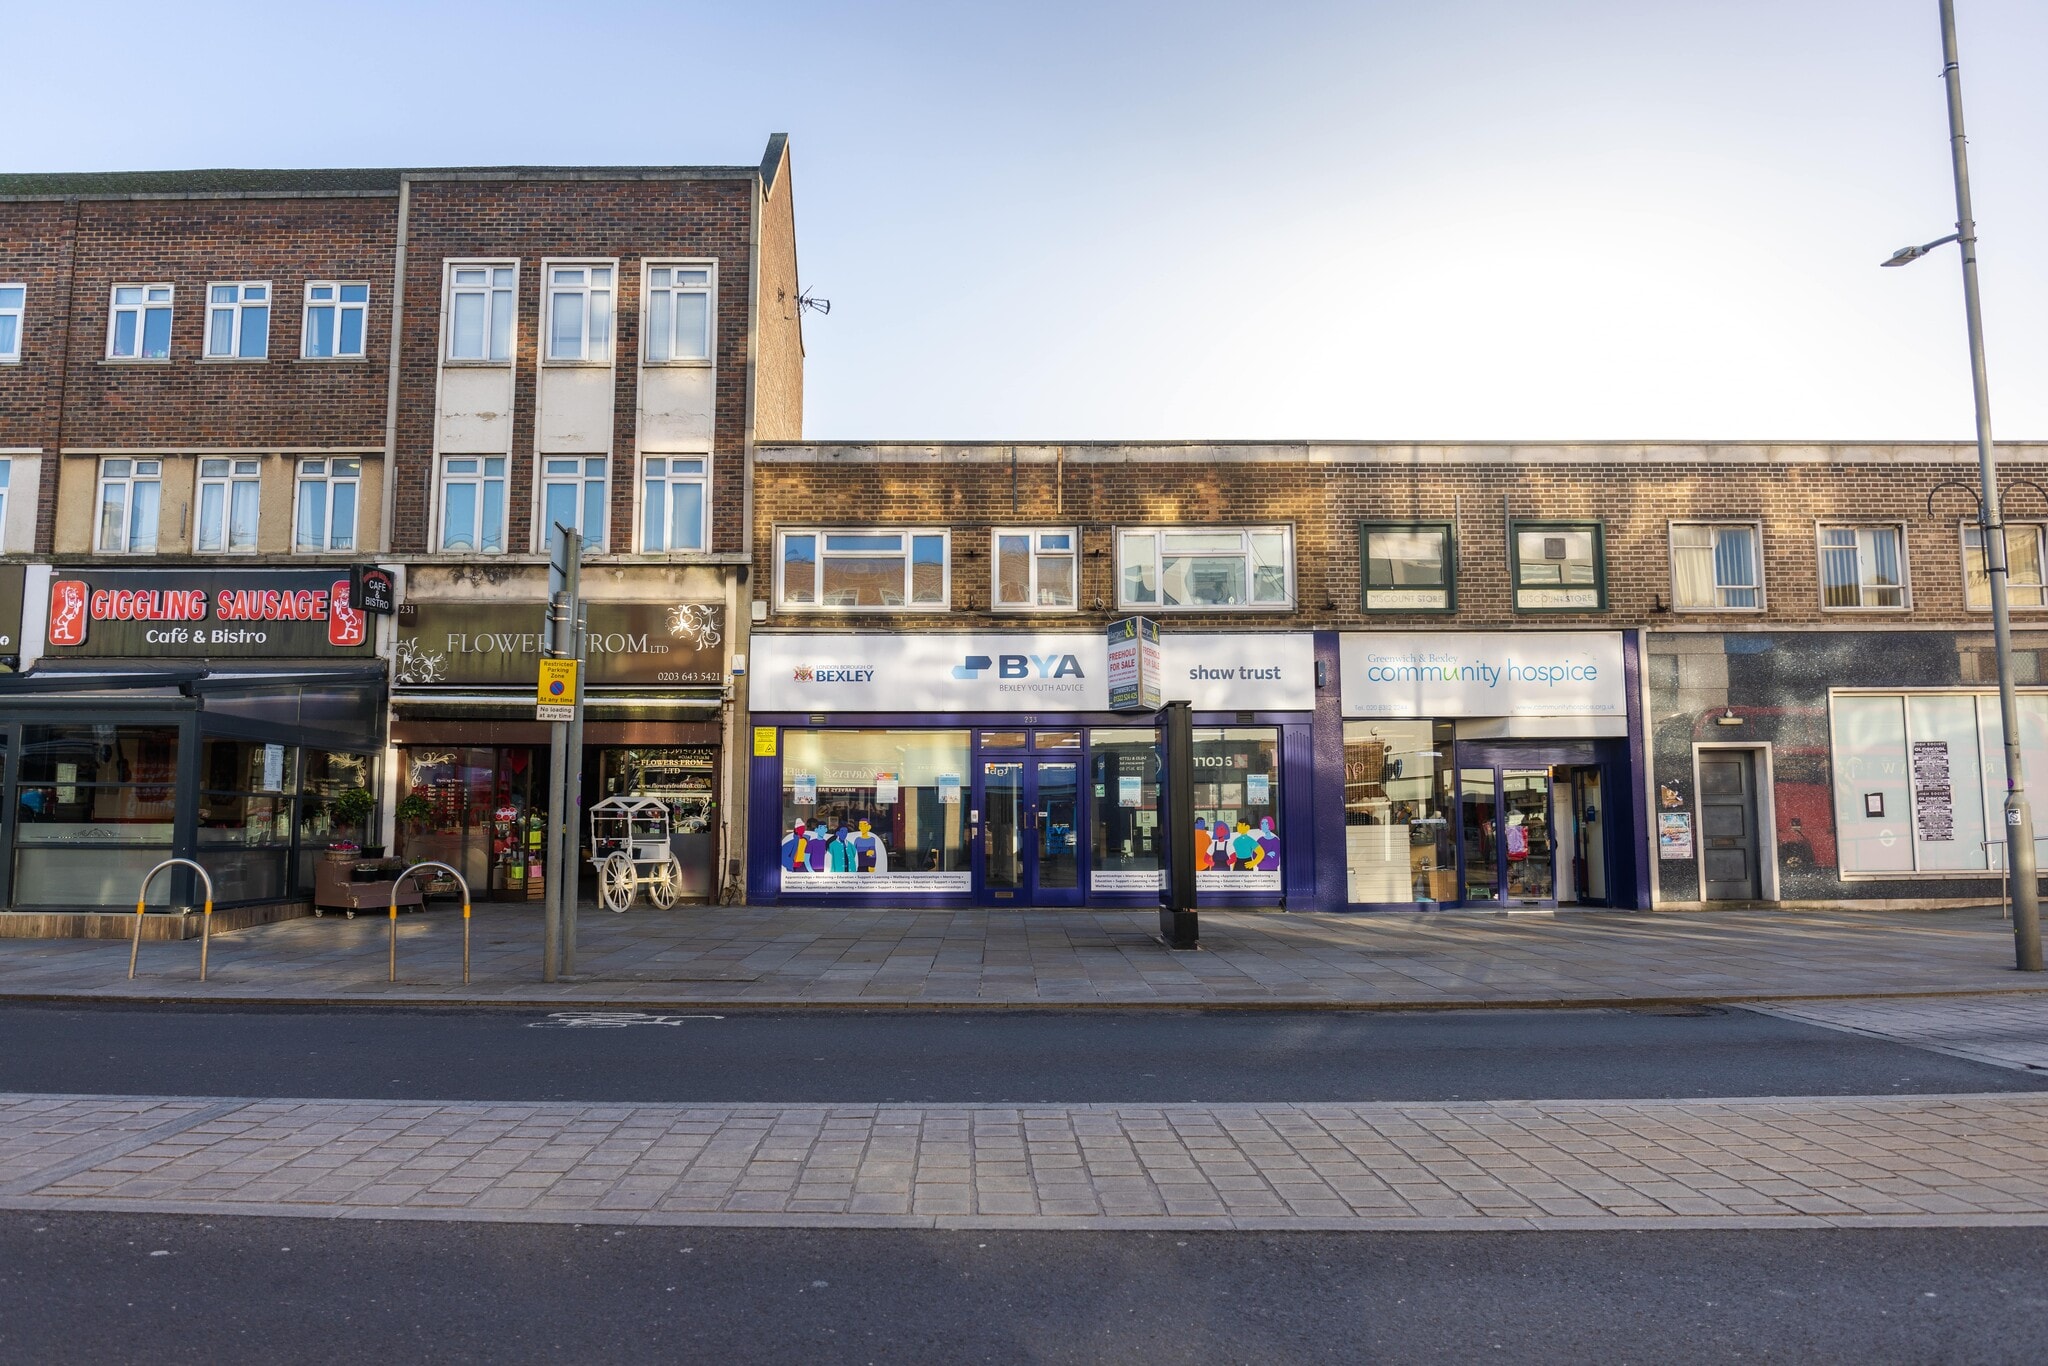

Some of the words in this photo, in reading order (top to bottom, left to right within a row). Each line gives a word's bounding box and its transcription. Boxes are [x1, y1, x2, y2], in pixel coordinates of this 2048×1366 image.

[374, 590, 380, 598] &
[91, 590, 206, 620] GIGGLING
[217, 590, 328, 620] SAUSAGE
[365, 596, 389, 610] BISTRO
[400, 606, 414, 614] 231
[146, 628, 188, 644] Café
[193, 630, 206, 644] &
[211, 628, 266, 644] Bistro
[447, 633, 545, 653] FLOWE
[584, 633, 648, 653] ROM
[650, 645, 669, 654] LTD
[1109, 648, 1136, 660] FREEHOLD
[1368, 654, 1416, 663] Greenwich
[1419, 654, 1426, 663] &
[1429, 654, 1458, 664] Bexley
[998, 654, 1085, 678] BYA
[1110, 662, 1120, 672] FOR
[1121, 659, 1135, 668] SALE
[1190, 664, 1235, 680] shaw
[1238, 666, 1282, 680] trust
[658, 672, 679, 680] 0203
[681, 672, 698, 680] 643
[701, 672, 720, 680] 5421
[816, 670, 874, 682] BEXLEY
[1368, 660, 1501, 688] community
[1508, 658, 1598, 687] hospice
[1024, 716, 1038, 724] 233
